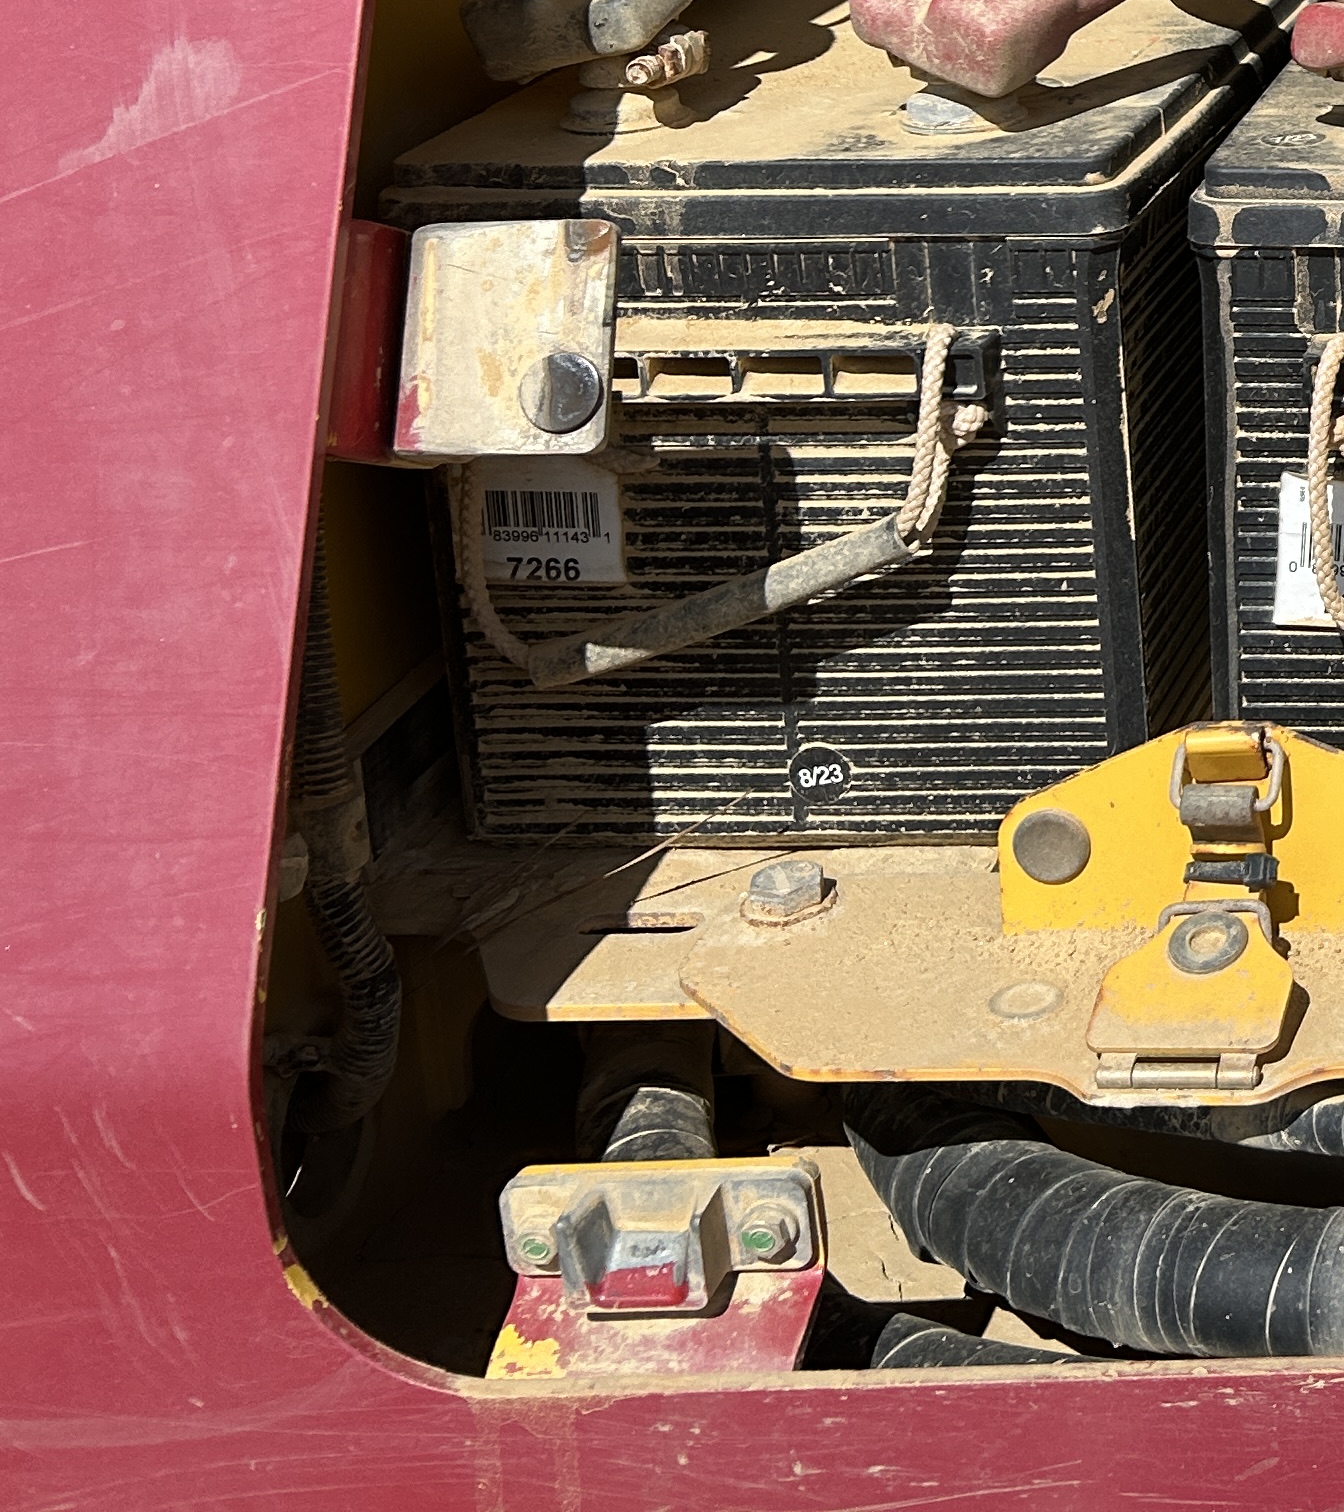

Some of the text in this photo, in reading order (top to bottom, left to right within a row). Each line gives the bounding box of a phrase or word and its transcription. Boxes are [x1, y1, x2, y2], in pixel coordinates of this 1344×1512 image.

[544, 531, 589, 544] 11143
[604, 532, 611, 544] 1
[506, 556, 581, 581] 7266
[799, 764, 844, 788] 8/23
